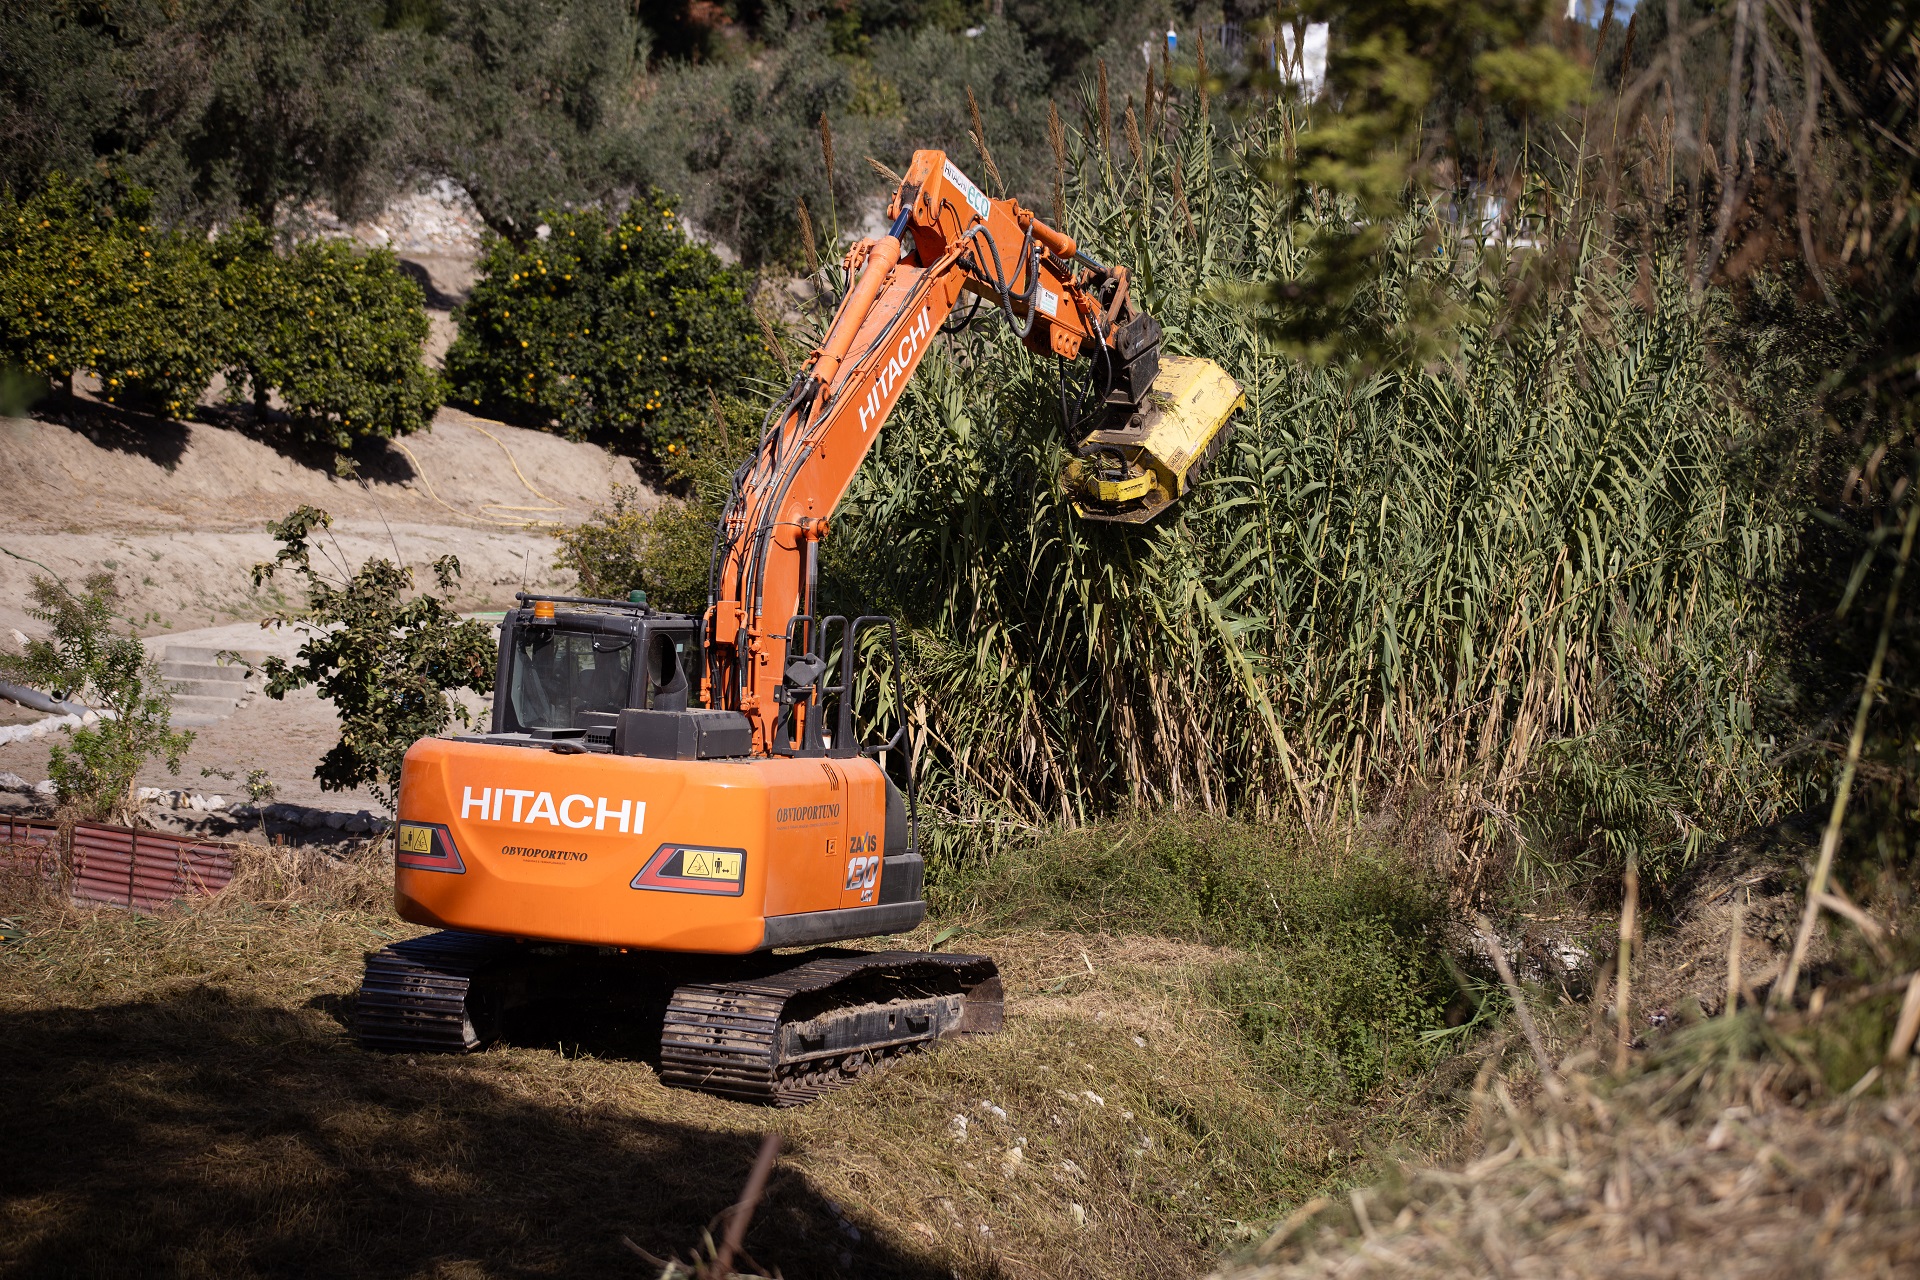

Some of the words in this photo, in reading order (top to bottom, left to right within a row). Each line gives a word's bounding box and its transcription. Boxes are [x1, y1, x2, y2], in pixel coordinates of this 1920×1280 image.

[967, 186, 989, 217] eco
[858, 305, 931, 432] HITACHI
[460, 786, 647, 835] HITACHI
[776, 803, 840, 823] OBVIOPORTUNO
[501, 845, 588, 862] OBVIOPORTUNO
[849, 831, 877, 854] ZAXIS
[845, 856, 880, 890] 130
